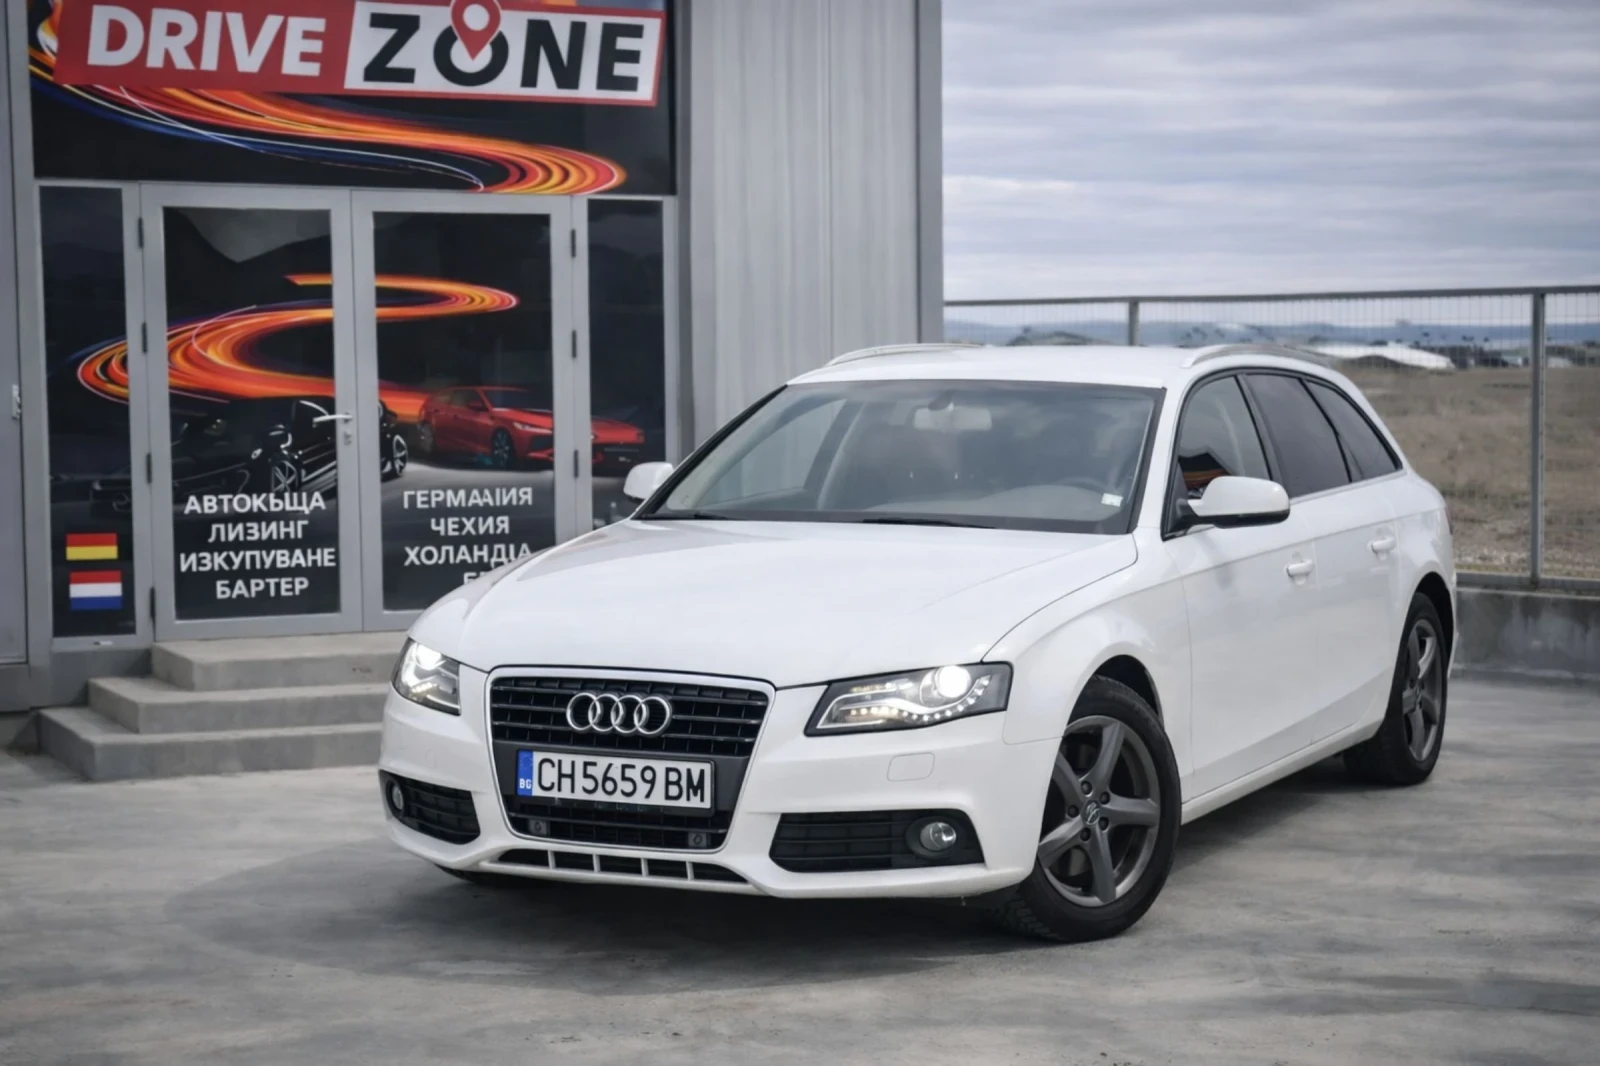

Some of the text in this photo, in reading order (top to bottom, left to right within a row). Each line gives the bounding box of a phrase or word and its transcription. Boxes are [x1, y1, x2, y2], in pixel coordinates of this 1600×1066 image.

[87, 4, 645, 92] DRIVE ZONE
[207, 520, 309, 543] ЛИЗИНГ
[430, 516, 510, 536] ЧЕХИЯ
[179, 548, 337, 572] ИЗКУПУВАНЕ
[215, 577, 309, 599] БАРТЕР
[519, 778, 532, 789] BG
